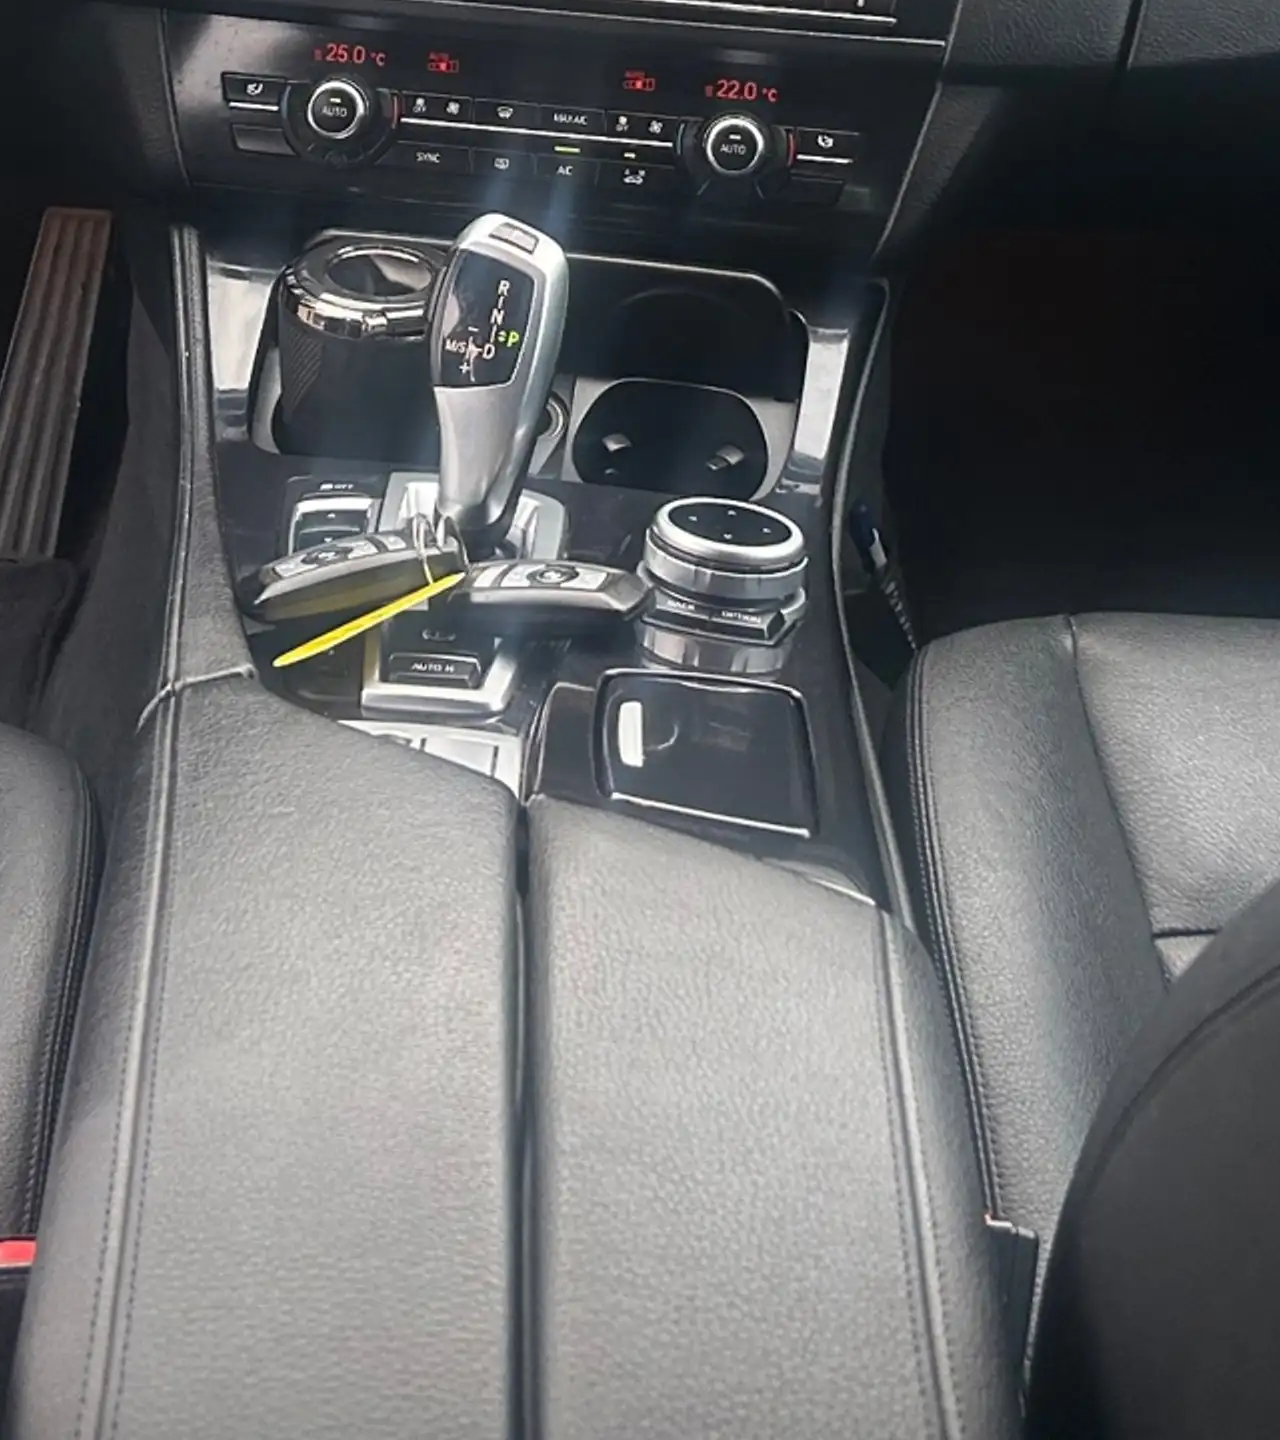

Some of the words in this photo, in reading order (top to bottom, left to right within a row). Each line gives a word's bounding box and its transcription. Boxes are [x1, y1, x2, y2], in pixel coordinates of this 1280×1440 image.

[716, 79, 758, 101] 22.0
[321, 104, 348, 118] AUTO
[415, 151, 441, 164] SYNC
[720, 142, 747, 156] AUTO
[497, 279, 511, 297] R
[490, 307, 505, 325] N
[506, 330, 520, 348] P
[444, 338, 467, 354] M/S
[482, 343, 496, 360] D
[410, 662, 442, 673] AUTO
